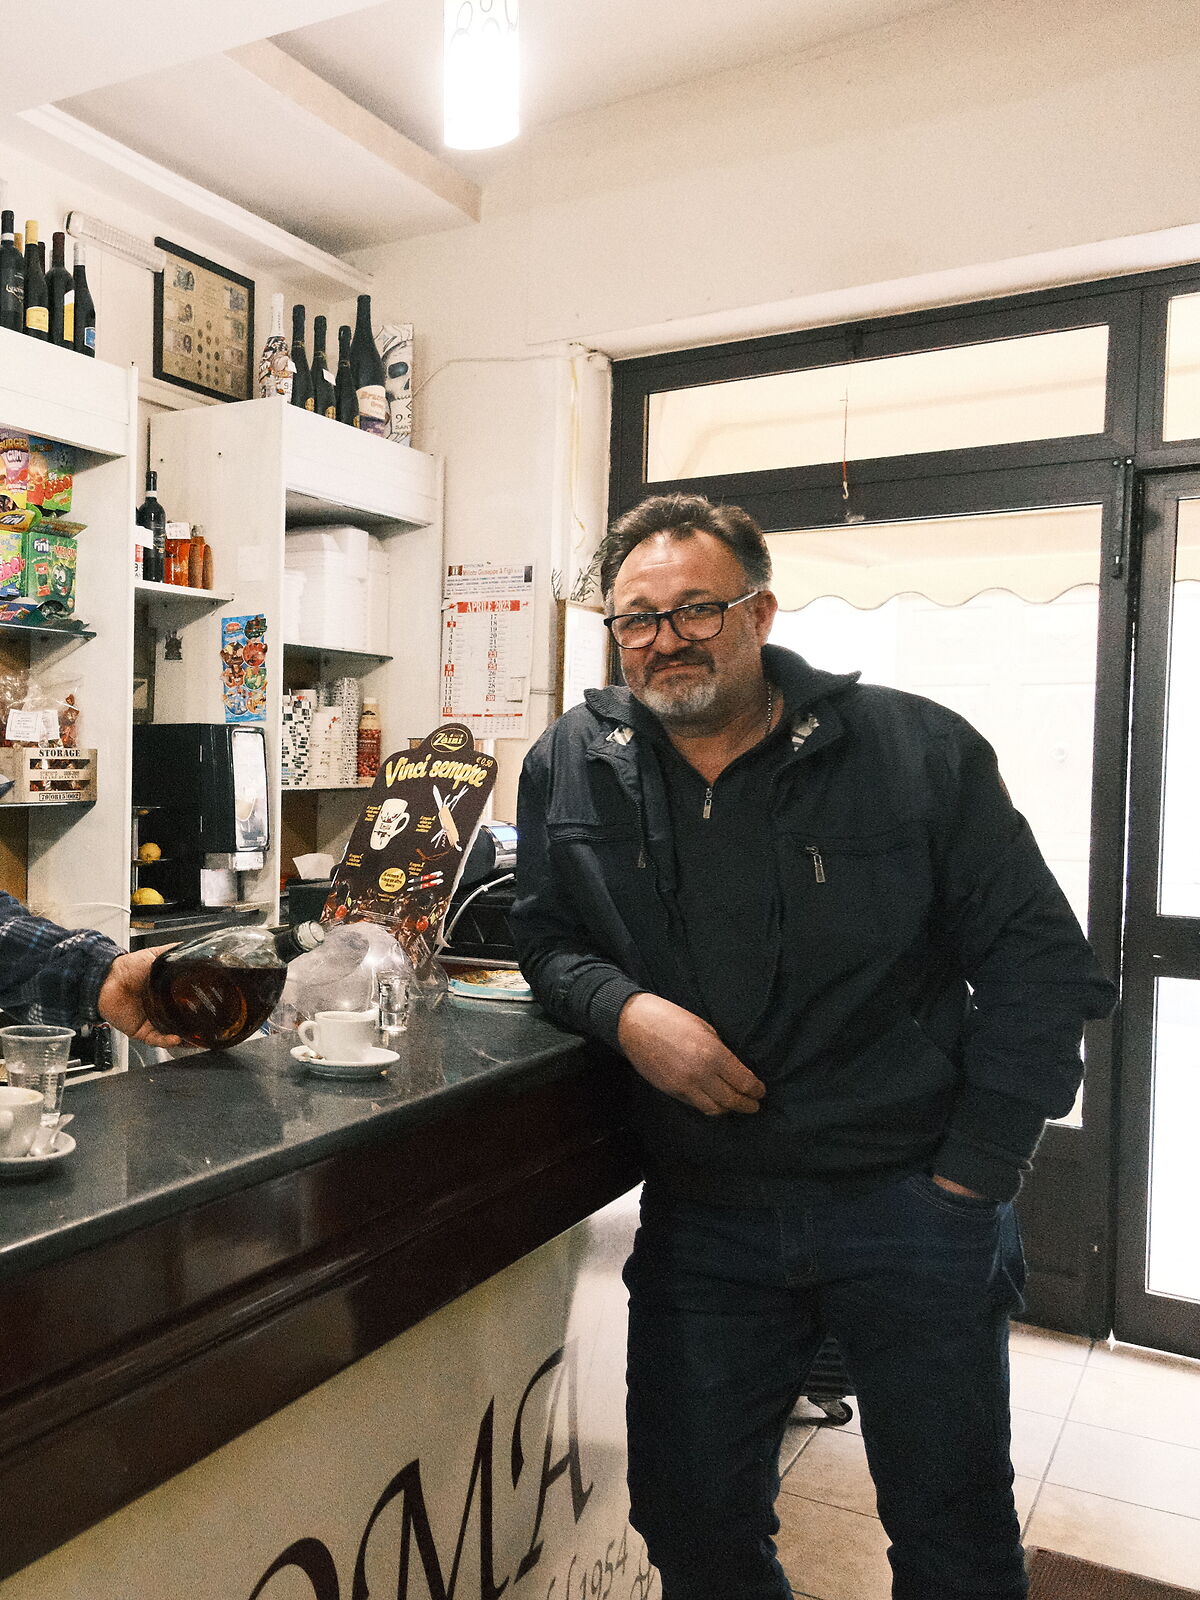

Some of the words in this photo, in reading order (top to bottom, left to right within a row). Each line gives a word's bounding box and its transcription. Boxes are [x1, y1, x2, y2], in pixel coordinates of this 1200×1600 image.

[0, 438, 28, 453] BURGER
[6, 450, 23, 463] GUM
[467, 601, 492, 613] APRILE
[494, 600, 510, 612] 2023
[39, 749, 80, 757] STORAGE
[386, 754, 432, 788] Vinci
[429, 760, 488, 790] sempre
